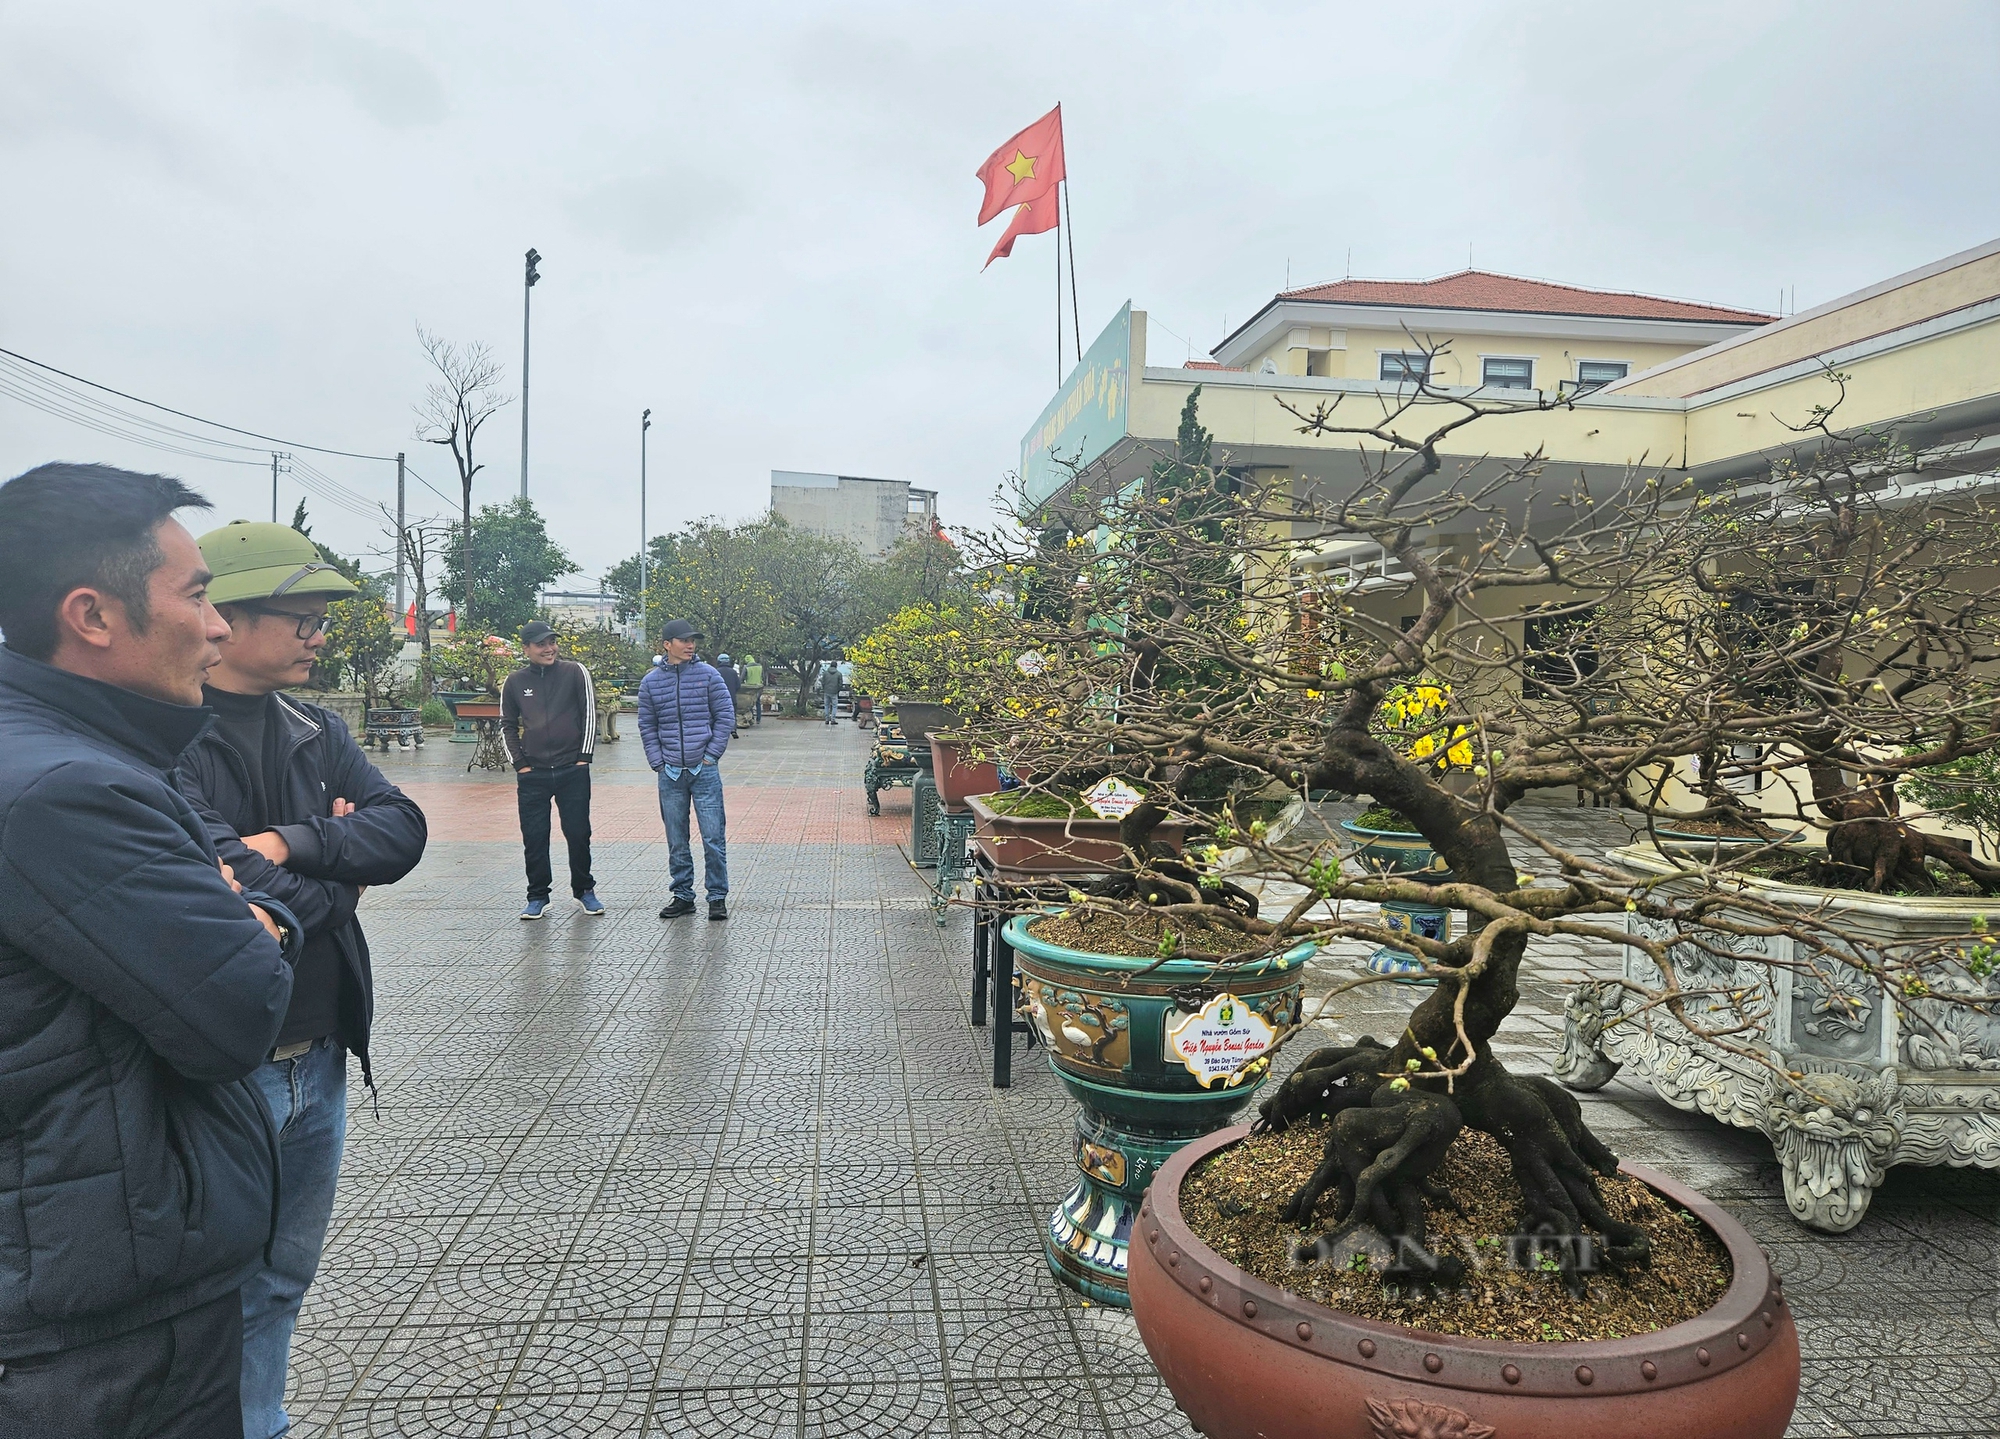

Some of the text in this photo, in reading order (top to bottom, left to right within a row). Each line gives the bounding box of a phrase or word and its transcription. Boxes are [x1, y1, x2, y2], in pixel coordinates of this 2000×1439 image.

[1200, 1038, 1222, 1056] Nguyễn
[1224, 1038, 1242, 1051] Bonsai
[1244, 1038, 1265, 1054] Garden
